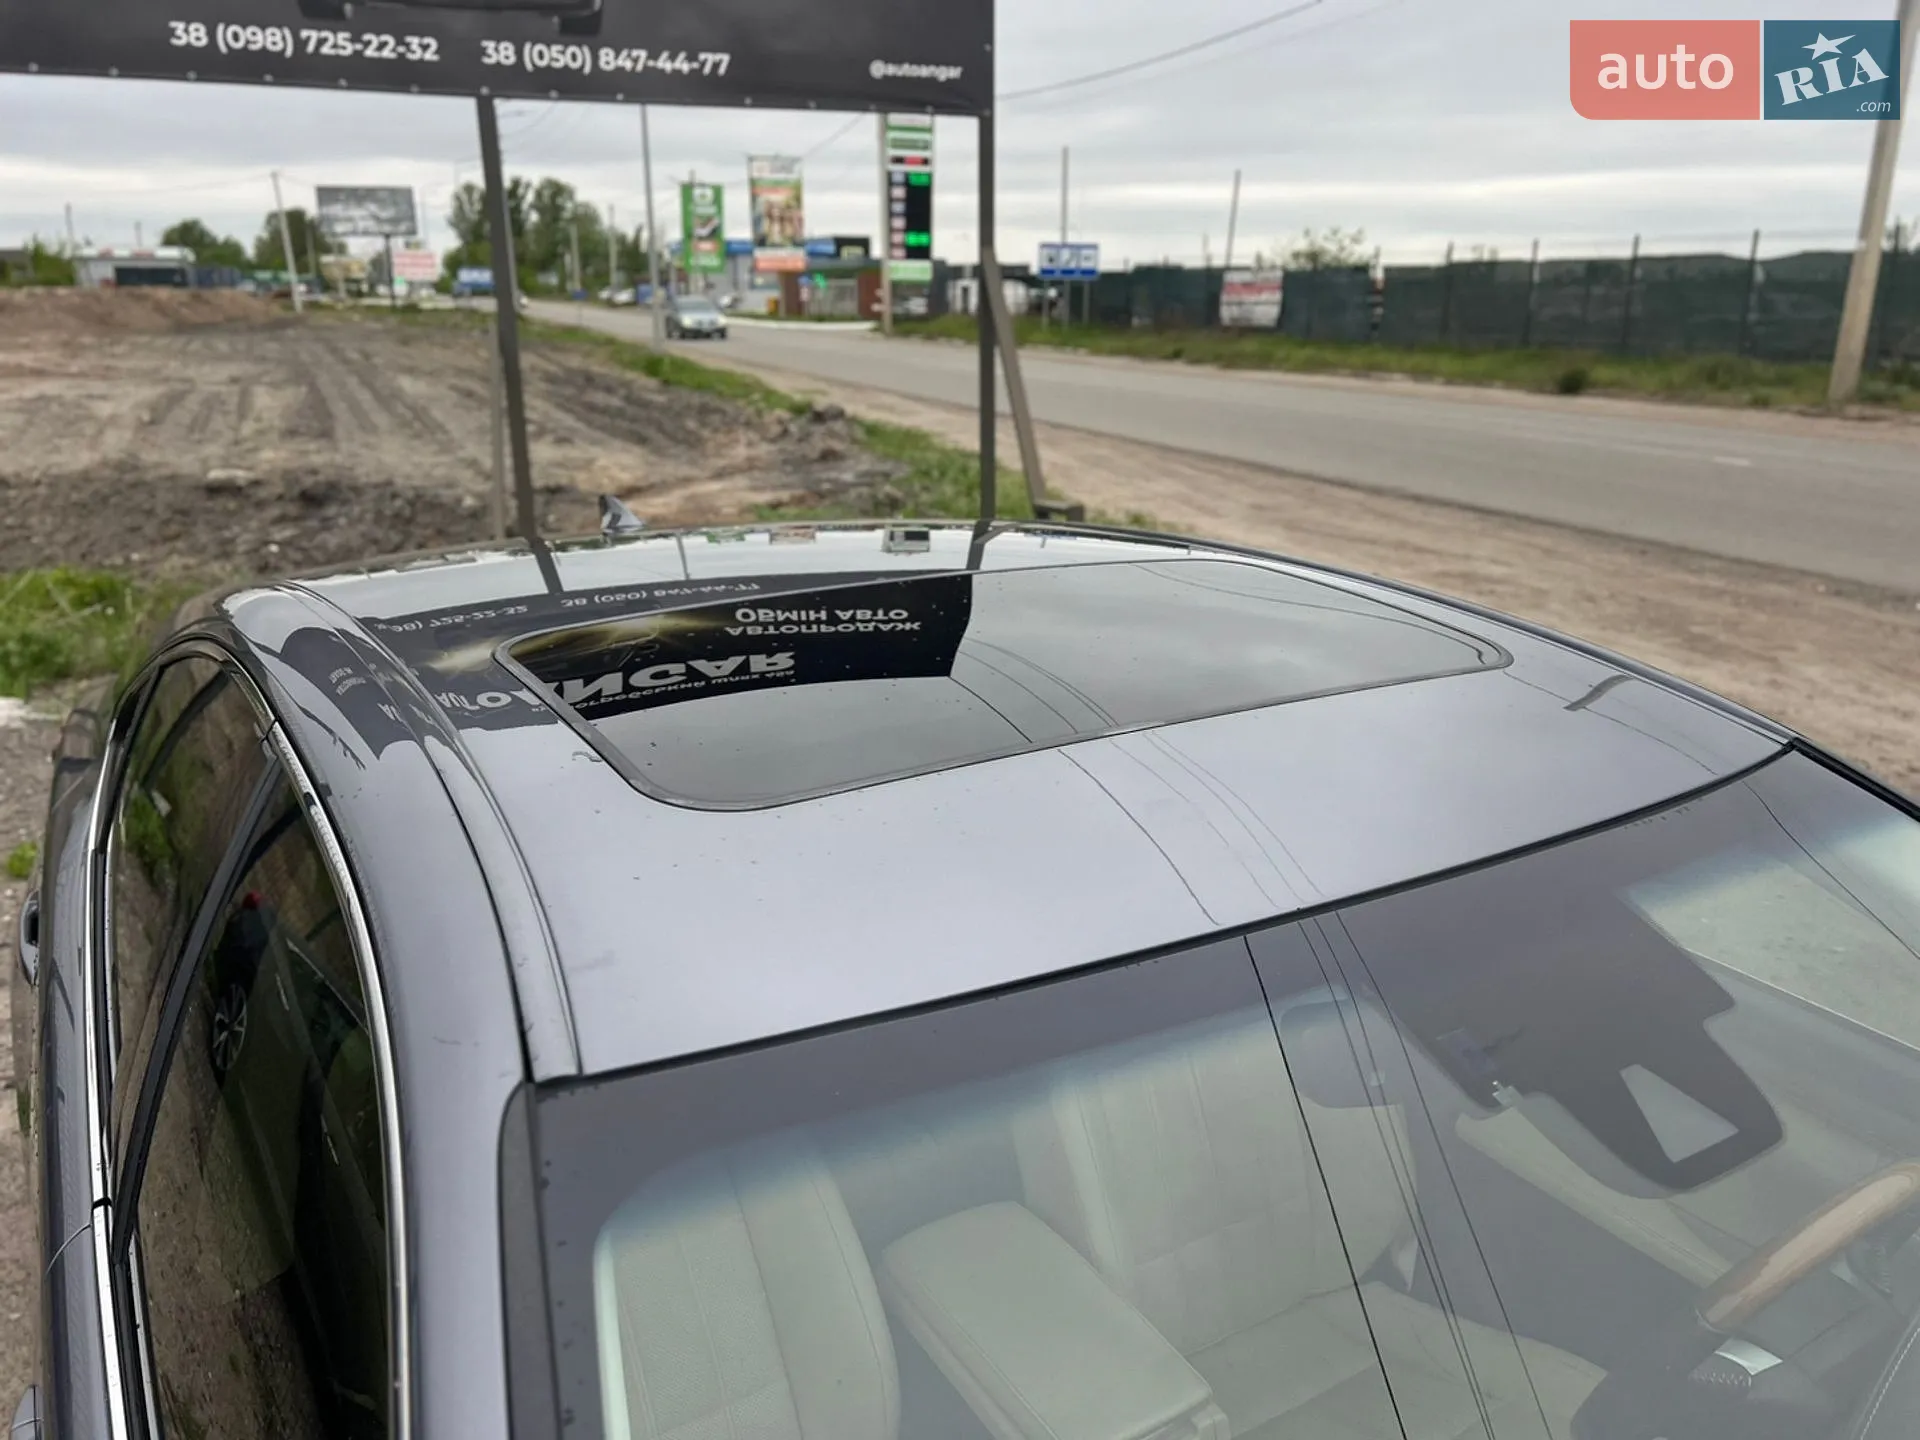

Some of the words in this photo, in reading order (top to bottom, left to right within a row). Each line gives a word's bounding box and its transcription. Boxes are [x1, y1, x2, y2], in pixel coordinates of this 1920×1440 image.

[168, 21, 208, 47] 38
[216, 22, 293, 58] (098)
[299, 29, 440, 62] 725-22-32
[480, 40, 517, 65] 38
[523, 41, 592, 75] (050)
[597, 47, 731, 76] 847-44-77
